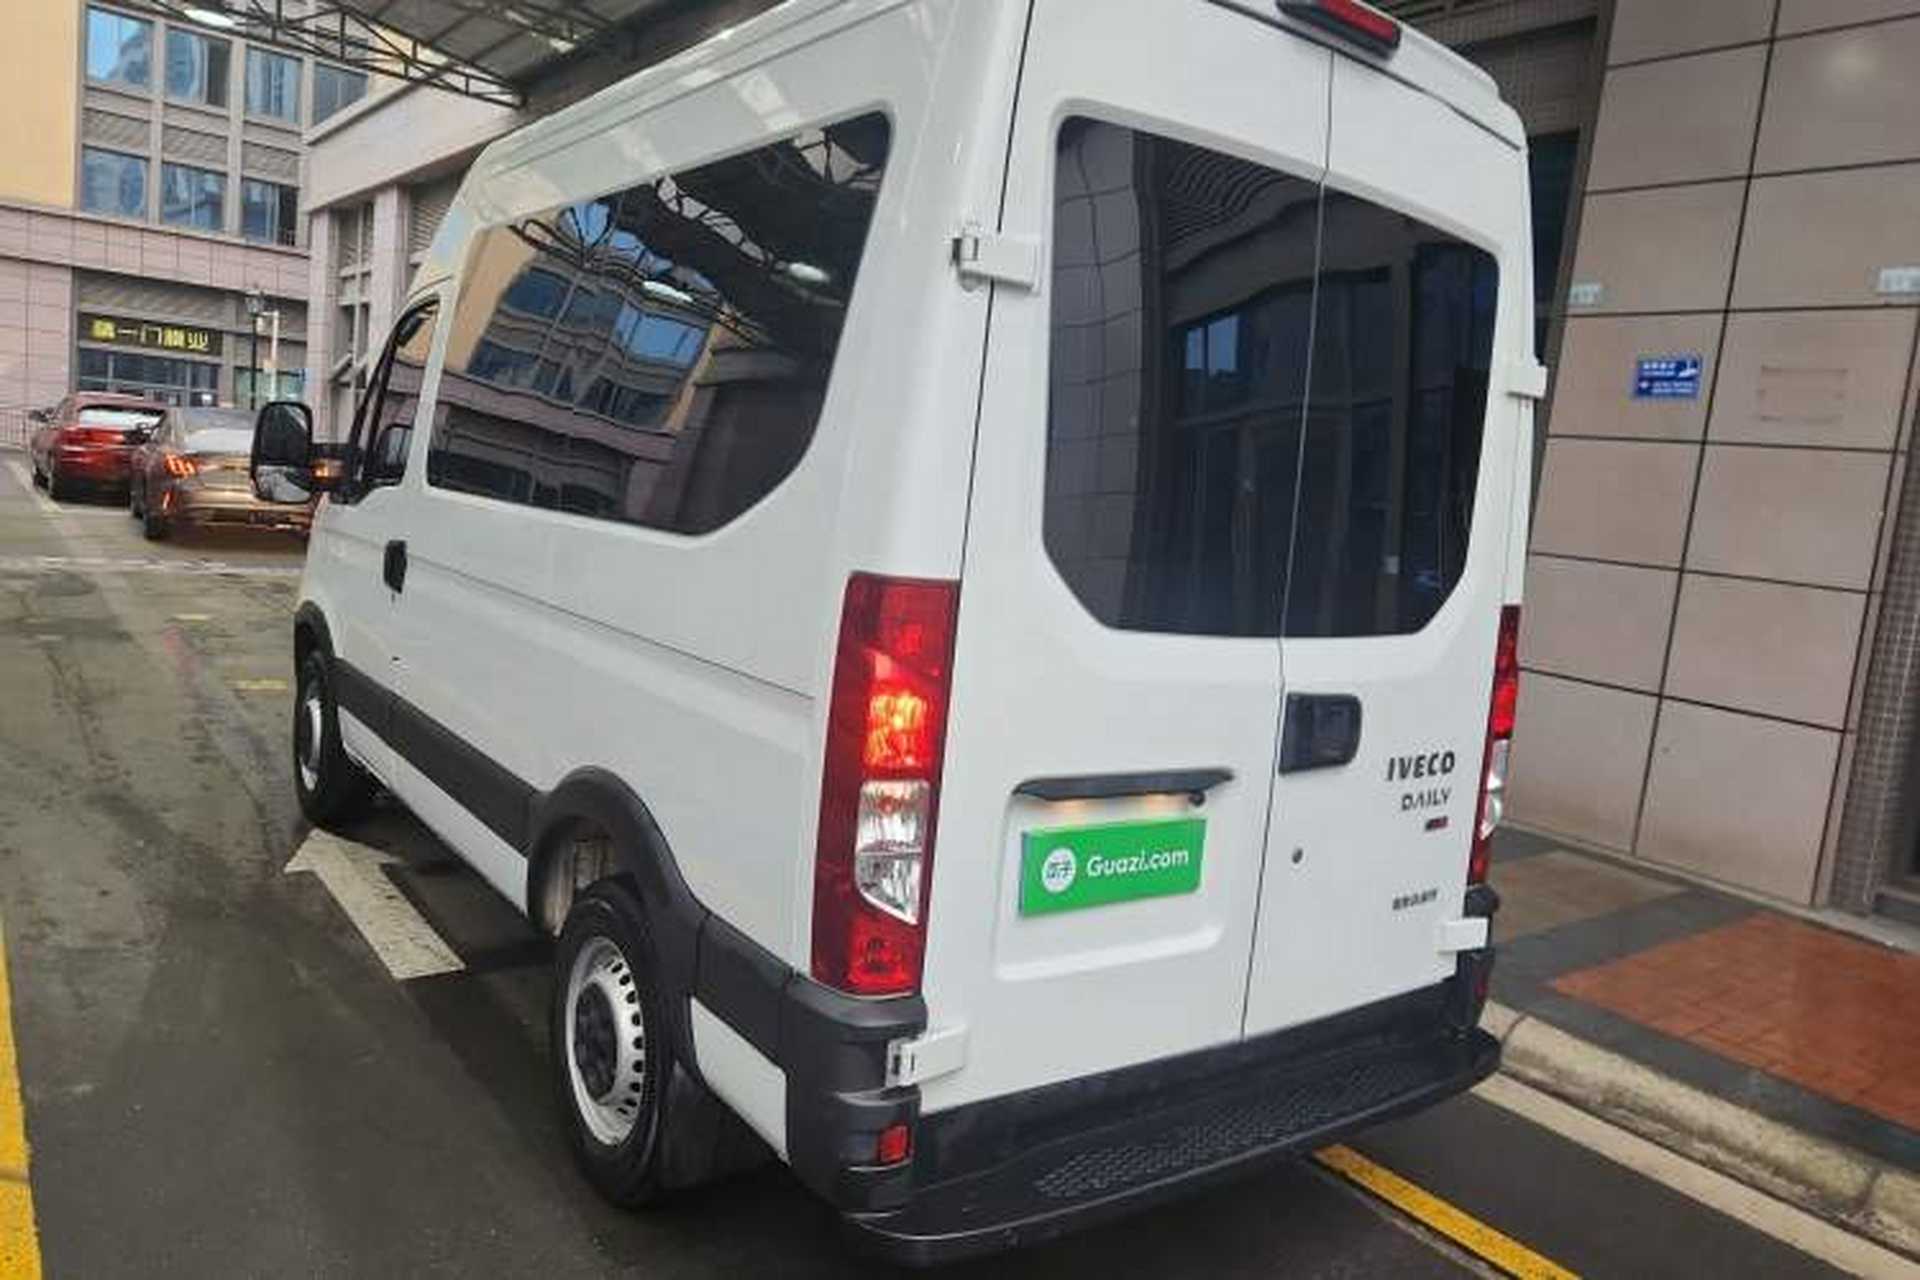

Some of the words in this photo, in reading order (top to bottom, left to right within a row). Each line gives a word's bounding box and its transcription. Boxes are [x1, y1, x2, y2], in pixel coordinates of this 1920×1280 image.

[1386, 750, 1456, 781] IVECO
[1401, 787, 1452, 811] DAILY
[1086, 848, 1189, 877] Guazi.com
